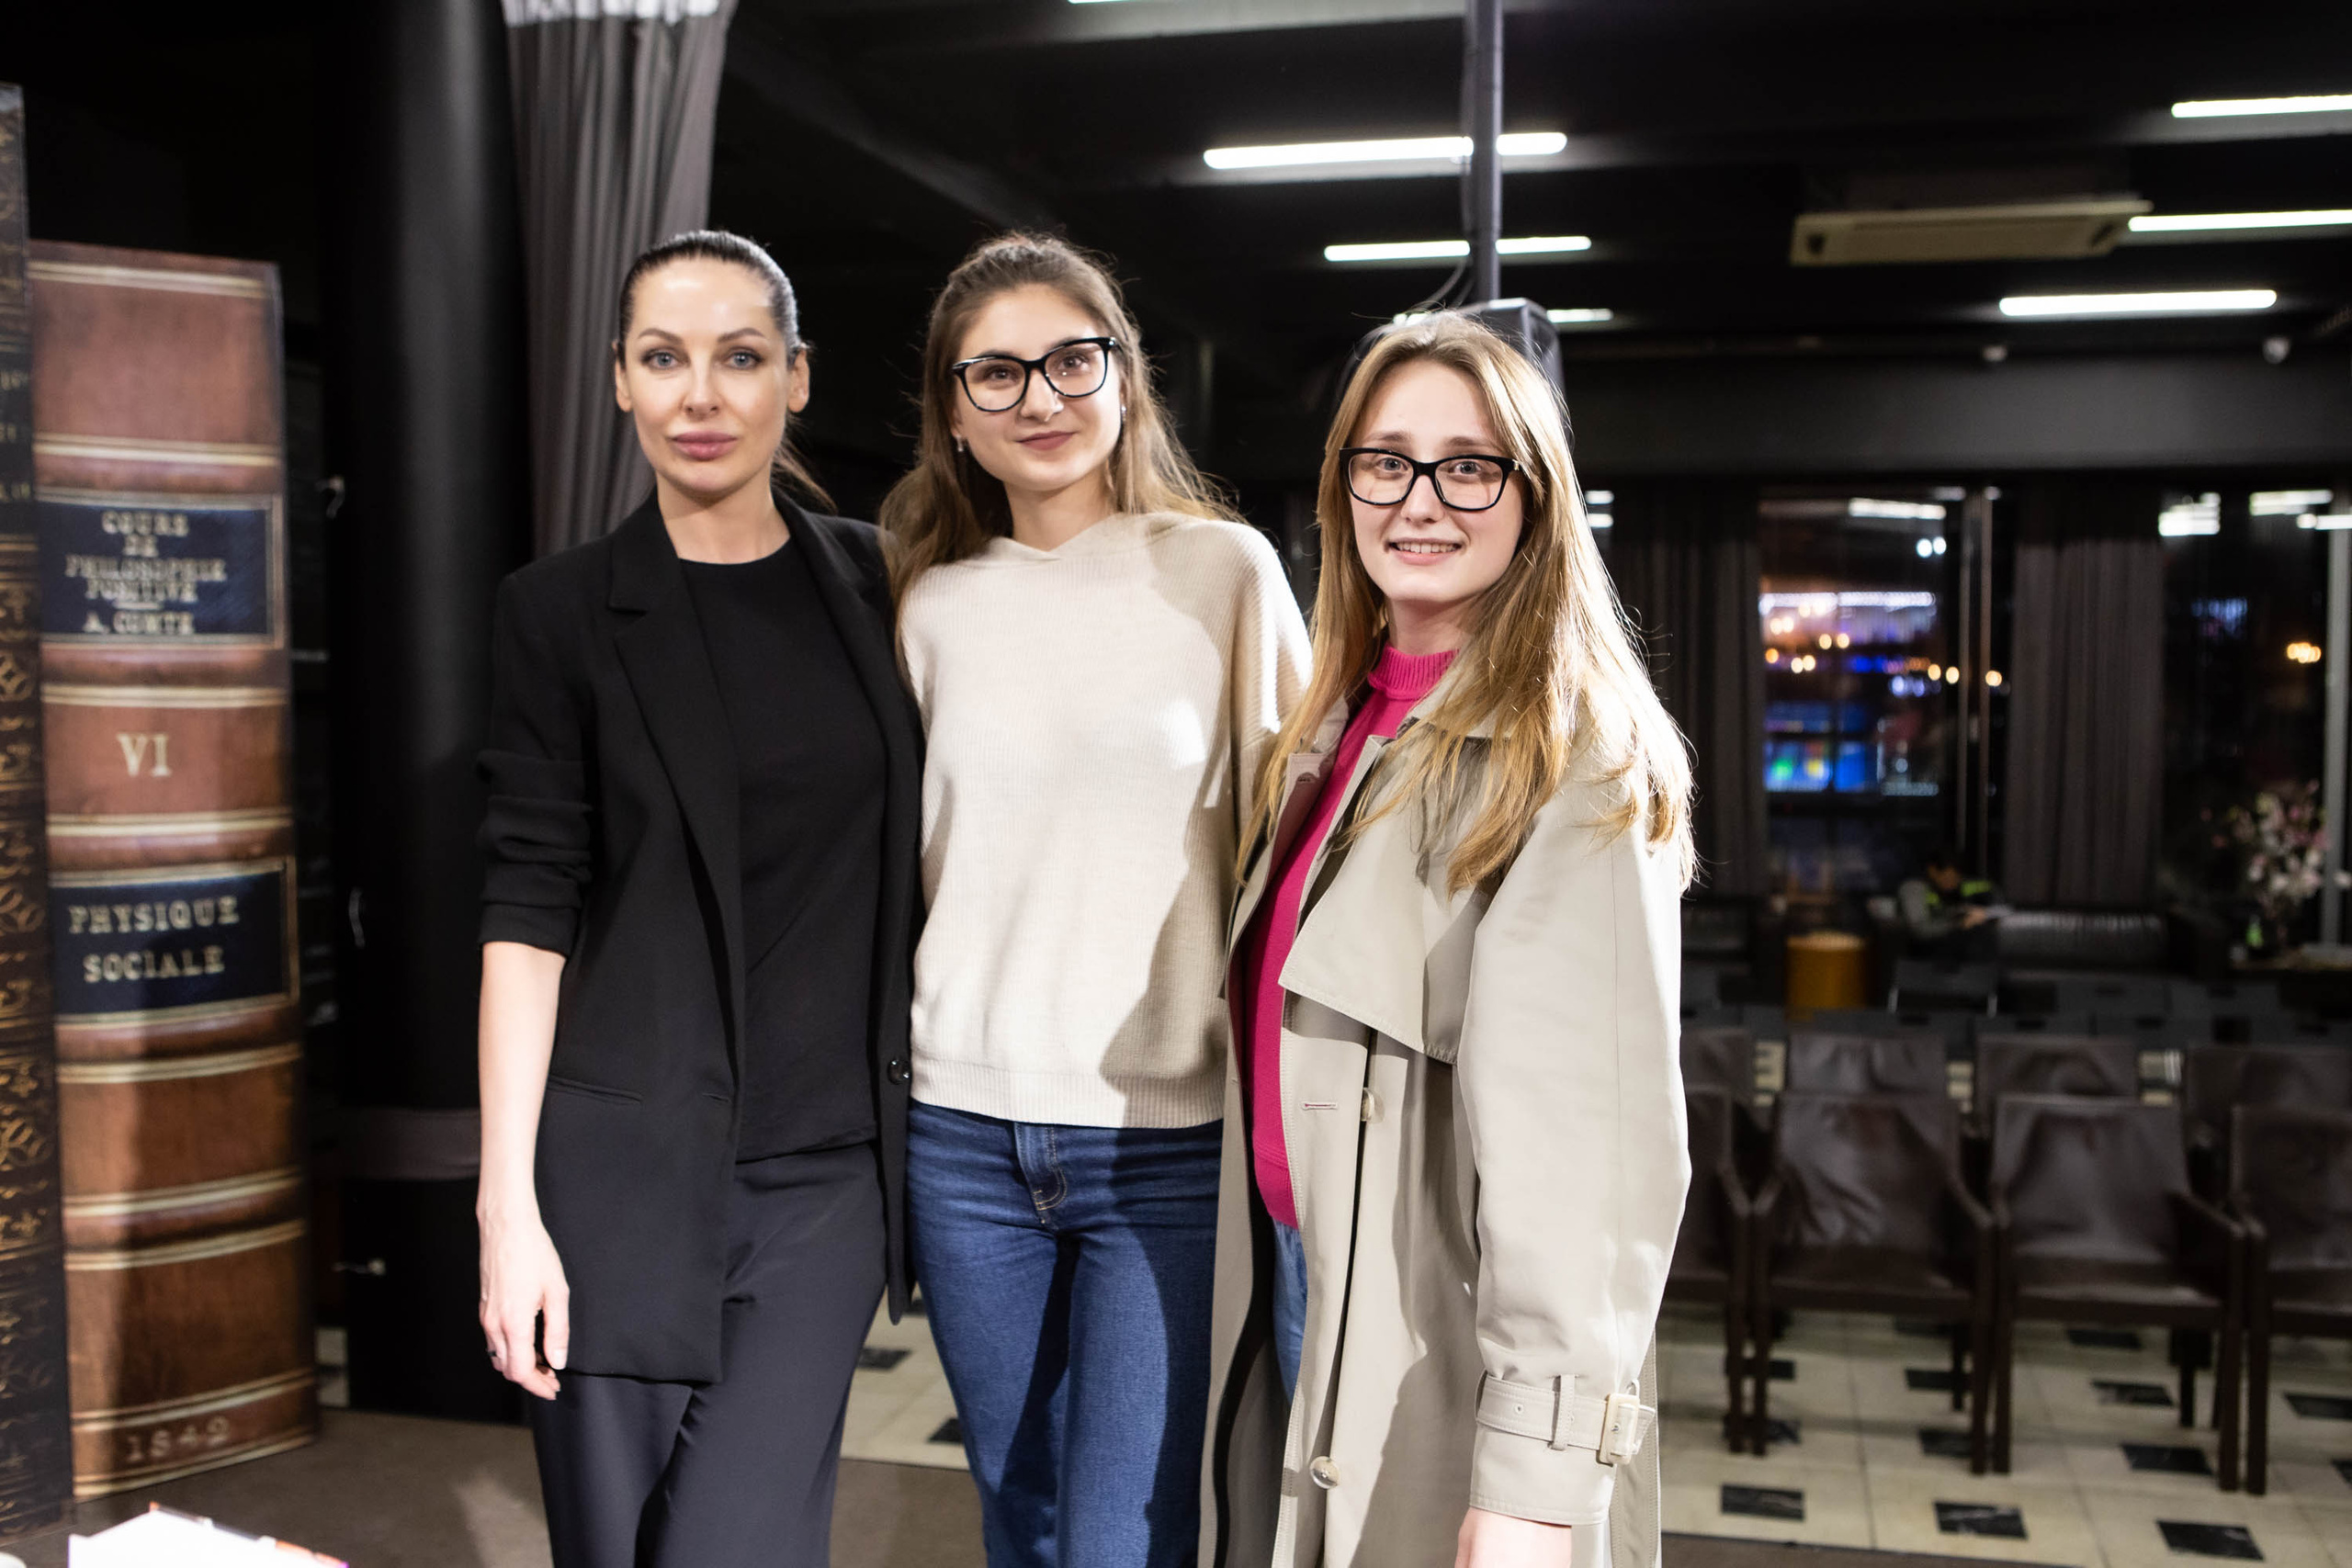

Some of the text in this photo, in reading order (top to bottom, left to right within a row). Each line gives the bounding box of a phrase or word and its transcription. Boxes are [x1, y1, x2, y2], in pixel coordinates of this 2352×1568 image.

[117, 733, 172, 777] VI
[68, 895, 240, 934] PHYSIQUE
[84, 944, 225, 984] SOCIALE
